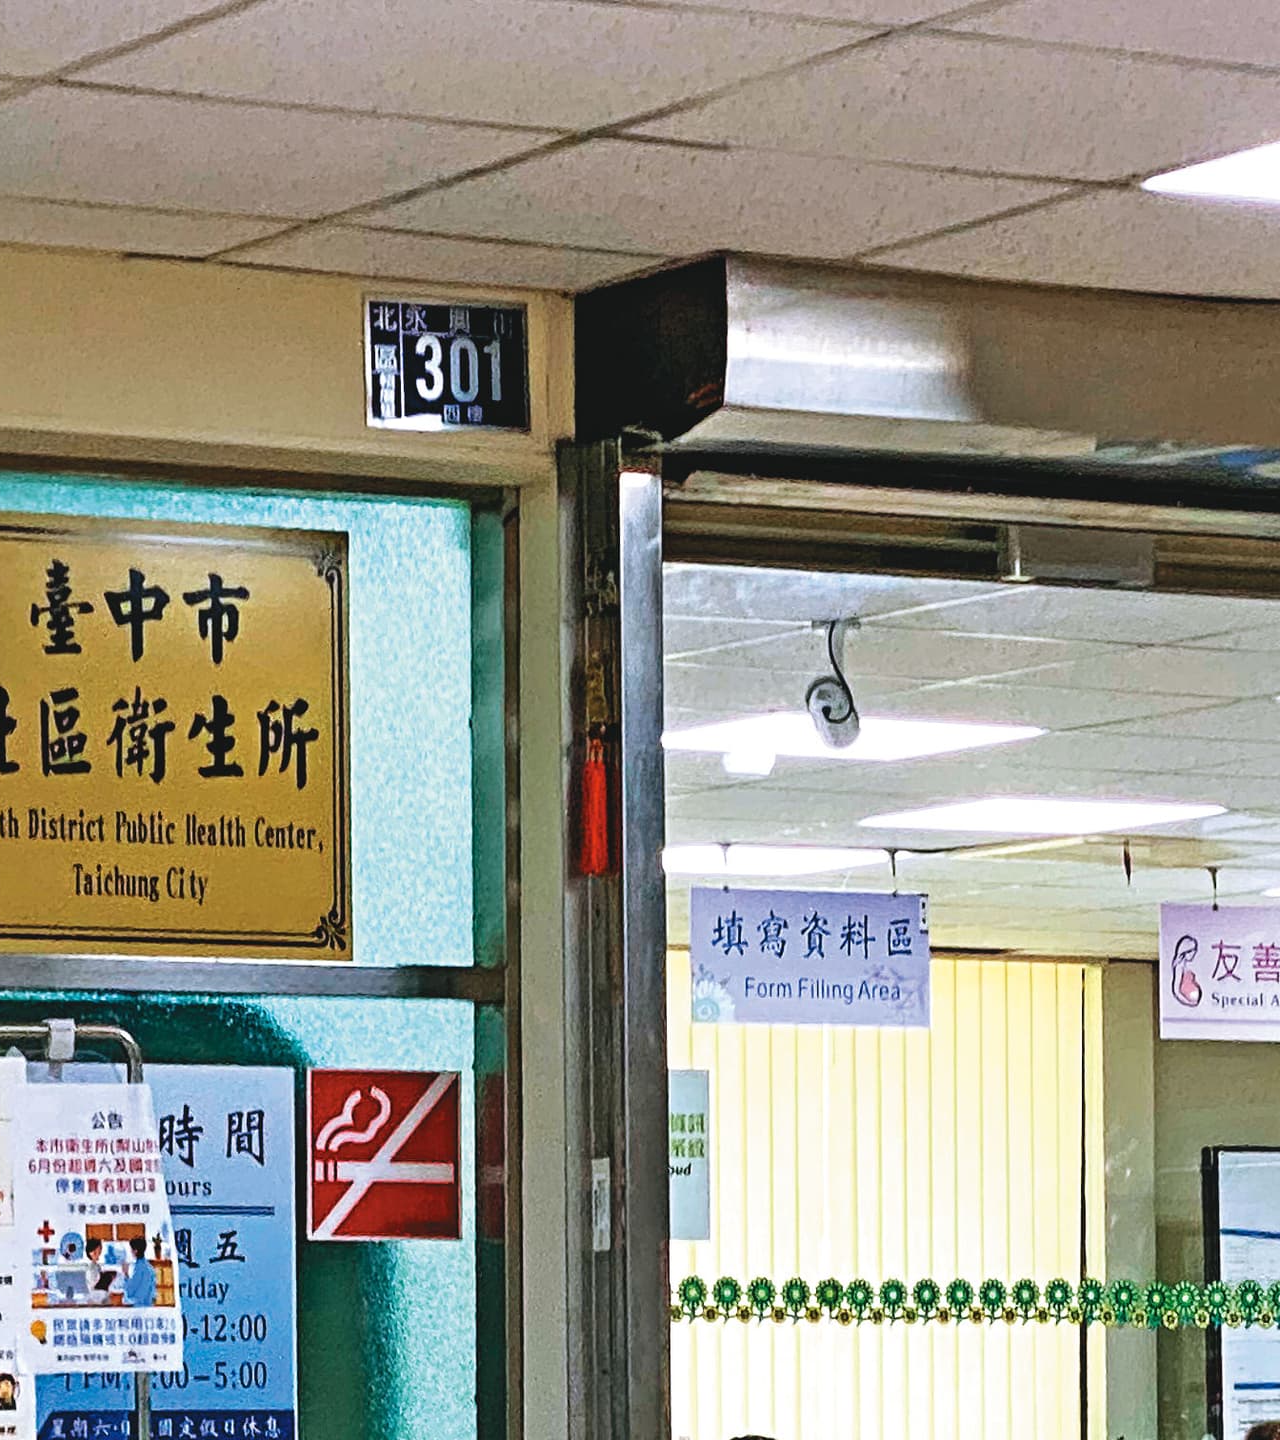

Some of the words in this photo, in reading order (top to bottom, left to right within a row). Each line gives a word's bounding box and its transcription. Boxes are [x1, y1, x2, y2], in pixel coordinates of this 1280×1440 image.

[415, 335, 502, 401] 301
[30, 559, 250, 664] 臺中市
[28, 808, 105, 842] District
[115, 811, 176, 846] Public
[185, 813, 247, 848] Health
[73, 864, 160, 902] Taichung
[166, 867, 209, 905] City
[711, 909, 912, 960] 填寫資料區
[745, 977, 791, 999] Form
[798, 978, 854, 1004] Filling
[858, 980, 900, 1000] Area
[1211, 992, 1263, 1009] Special
[91, 1111, 124, 1131] 公告
[160, 1104, 265, 1168] 時間
[166, 1180, 212, 1196] ours
[179, 1277, 229, 1304] riday
